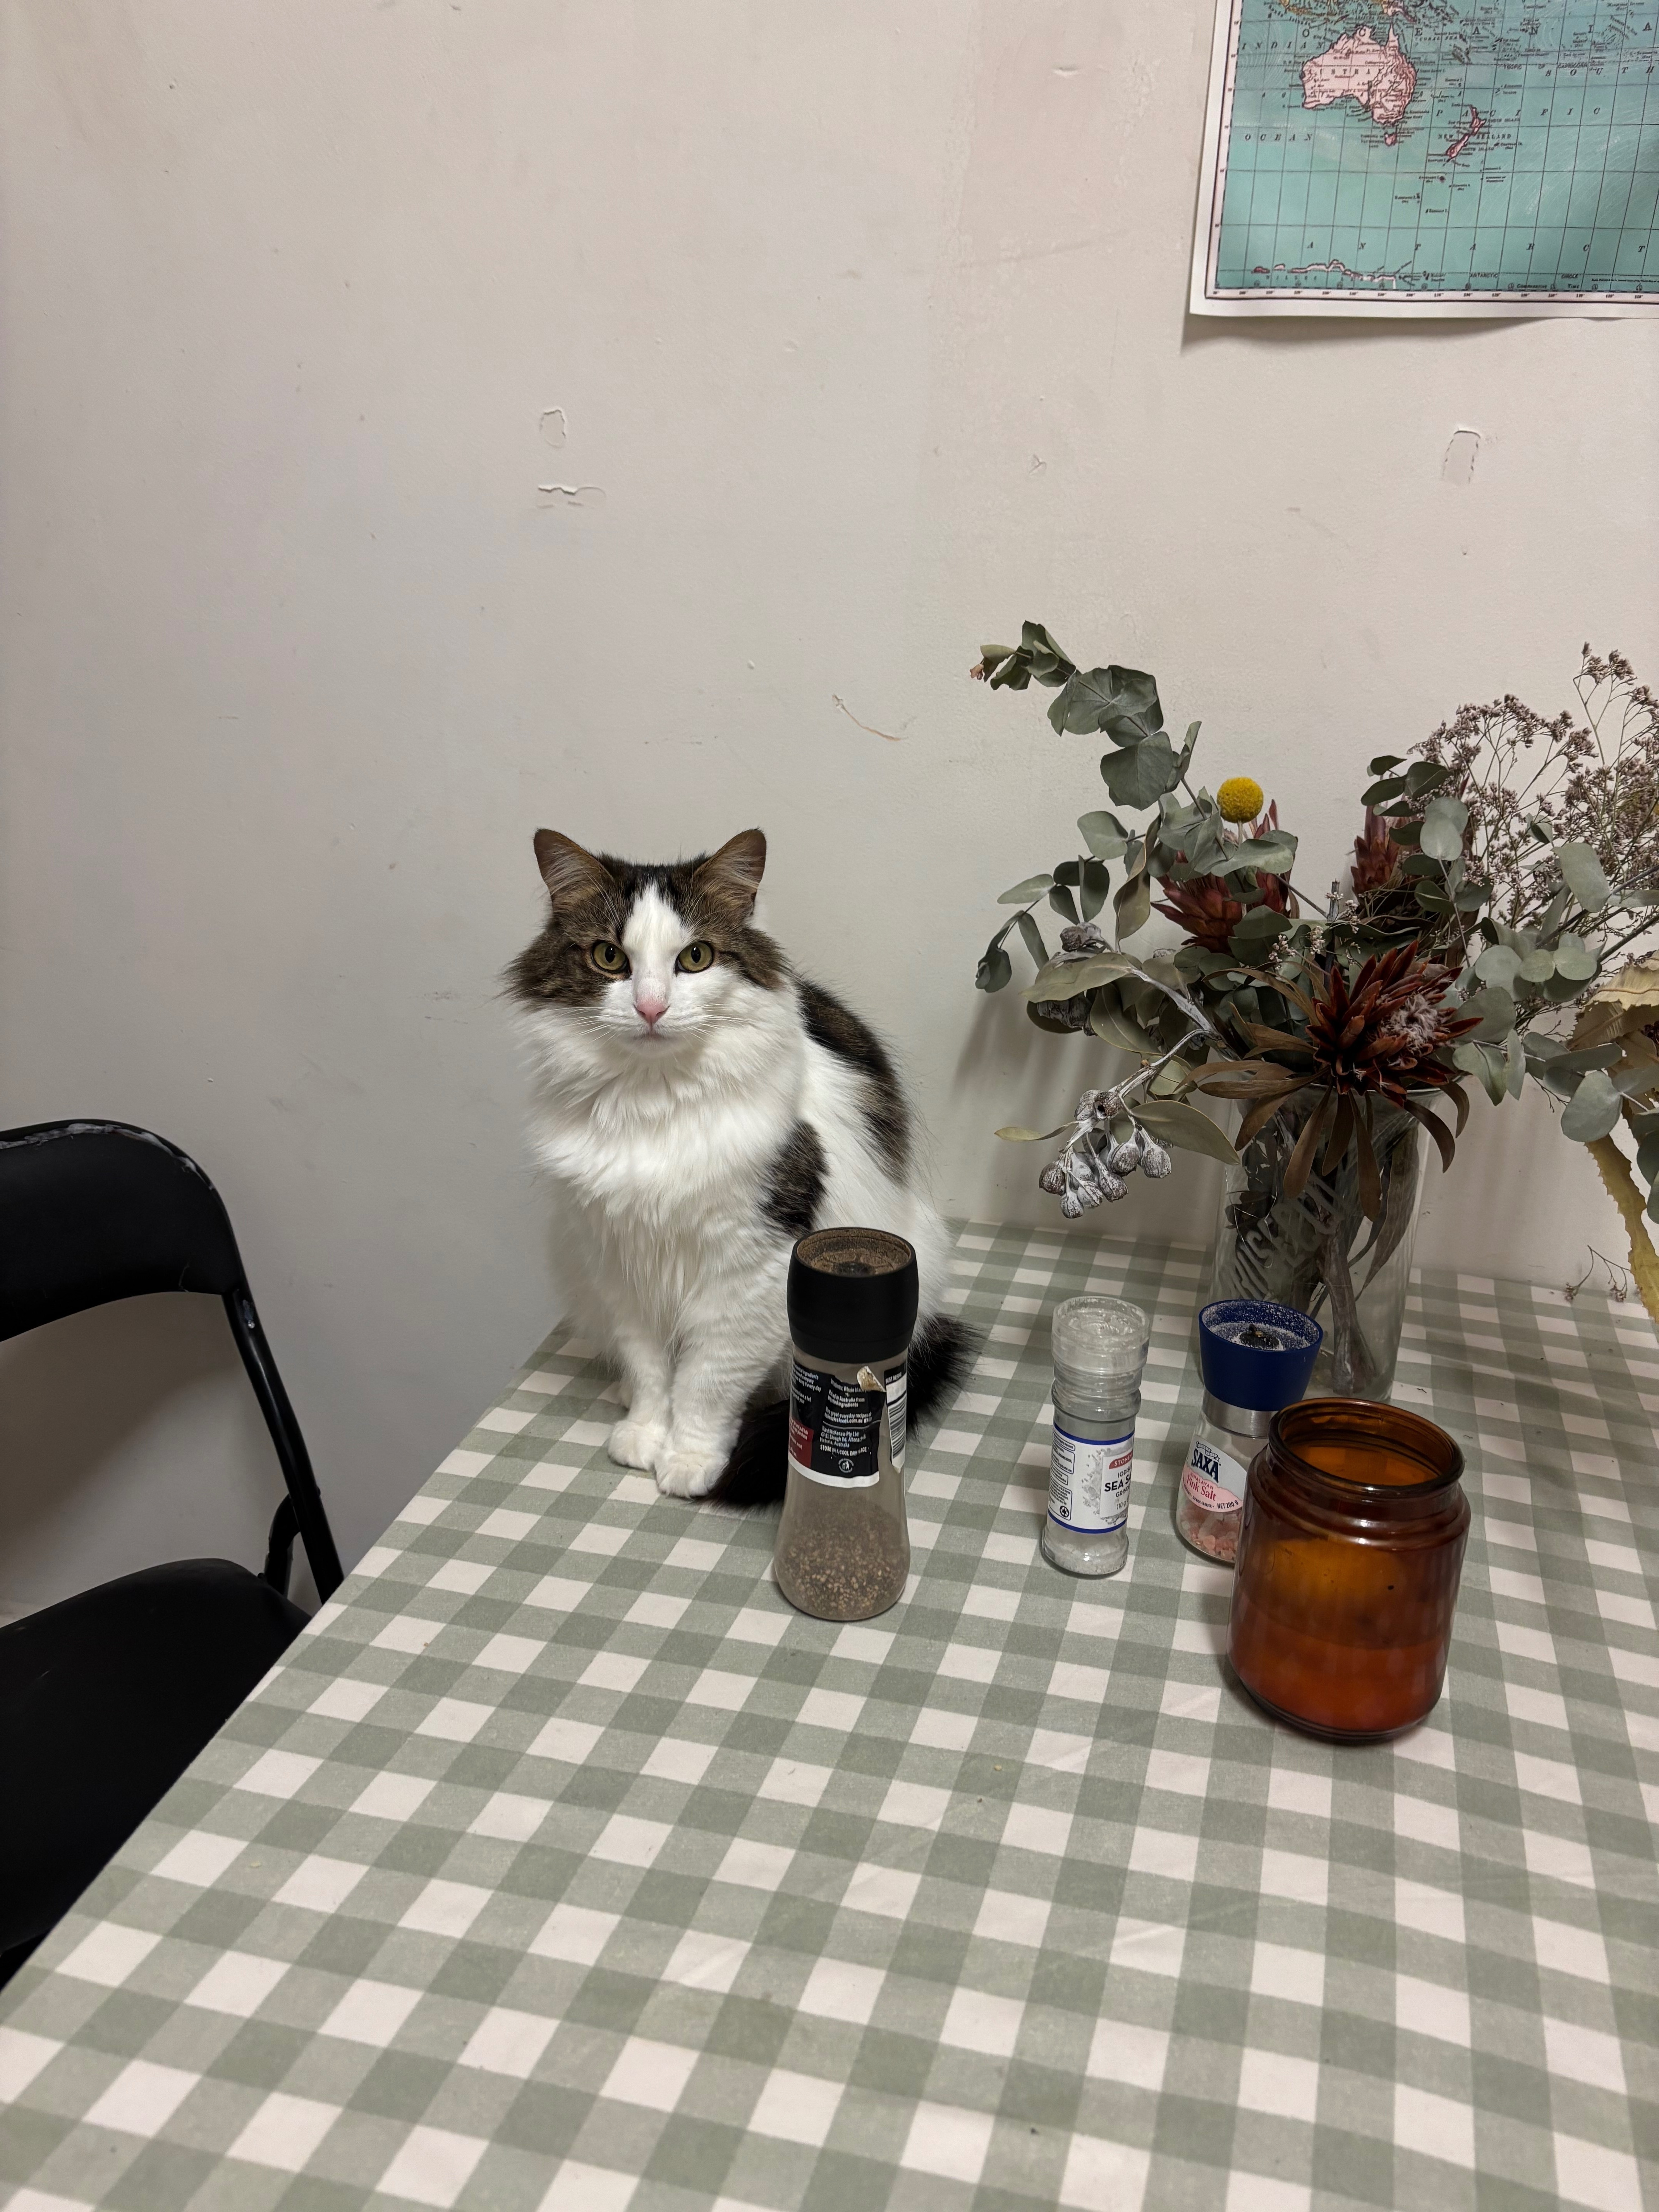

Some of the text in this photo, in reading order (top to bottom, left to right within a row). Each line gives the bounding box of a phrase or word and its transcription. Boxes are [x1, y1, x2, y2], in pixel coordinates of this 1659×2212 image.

[1242, 41, 1324, 50] INDIAN
[1191, 1448, 1219, 1484] SAXA
[1104, 1479, 1124, 1492] SEA
[1187, 1474, 1199, 1492] Pink
[1200, 1486, 1216, 1501] Salt
[1190, 1472, 1214, 1490] HIMALAYAN
